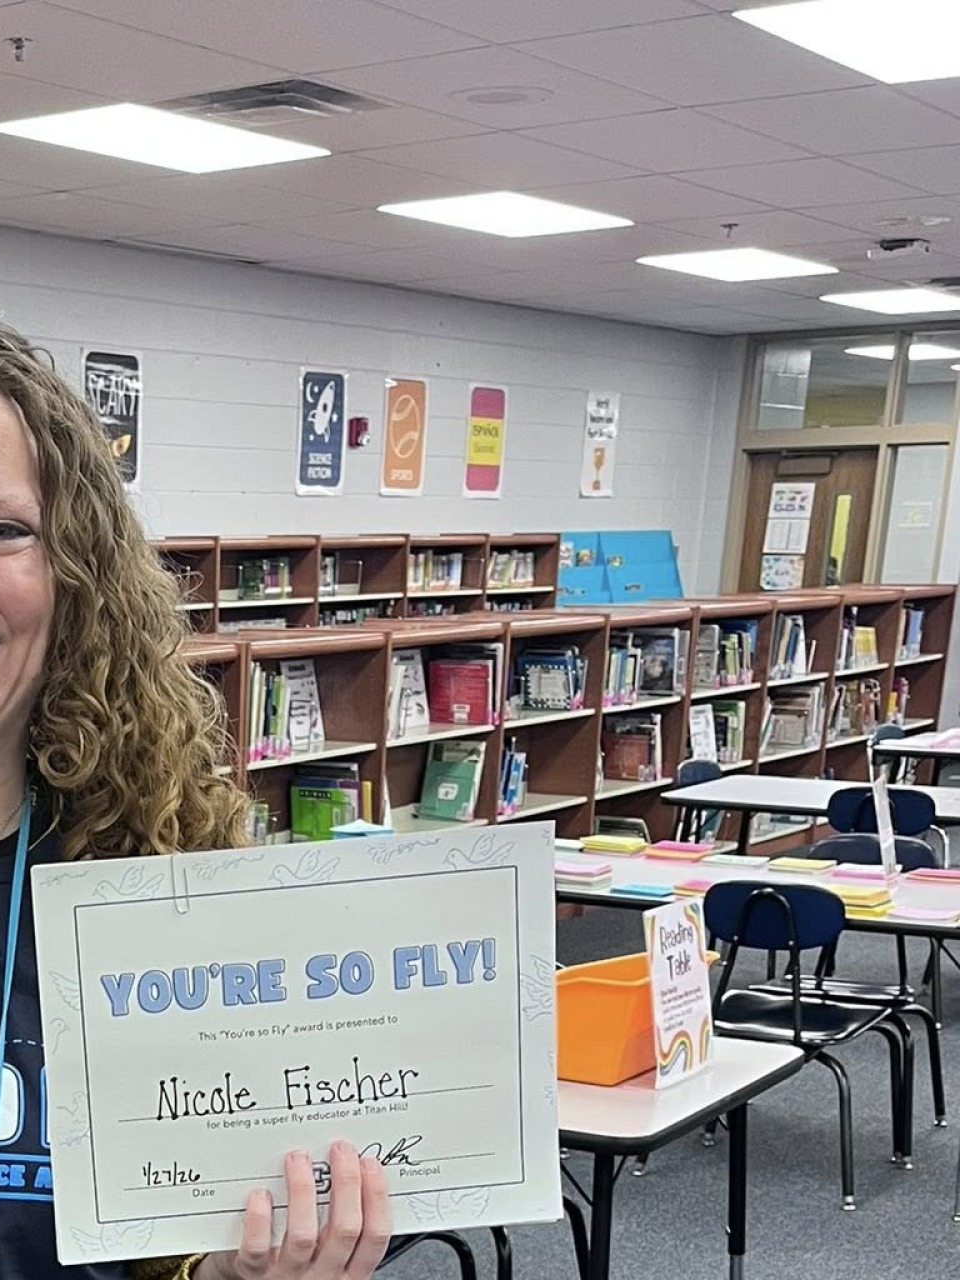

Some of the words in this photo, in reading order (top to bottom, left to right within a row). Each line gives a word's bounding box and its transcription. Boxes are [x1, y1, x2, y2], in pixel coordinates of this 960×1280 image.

[660, 921, 693, 954] Reading
[100, 958, 287, 1017] YOU'RE
[305, 950, 375, 999] SO
[393, 938, 497, 991] FLY!
[666, 949, 692, 981] Table
[198, 1032, 217, 1042] This
[258, 1028, 269, 1037] so
[293, 1022, 324, 1034] award
[326, 1021, 333, 1031] is
[335, 1015, 385, 1031] presented
[387, 1015, 398, 1025] to
[157, 1072, 257, 1120] Nicole
[284, 1056, 420, 1110] Fischer
[206, 1121, 220, 1130] for
[223, 1118, 252, 1130] being
[254, 1118, 260, 1126] a
[262, 1115, 289, 1128] super
[291, 1113, 304, 1124] fly
[307, 1109, 350, 1121] educator
[352, 1108, 362, 1117] at
[365, 1105, 388, 1115] Titan
[142, 1161, 201, 1186] 1/27/26
[400, 1165, 441, 1177] Principal
[192, 1188, 216, 1198] Date
